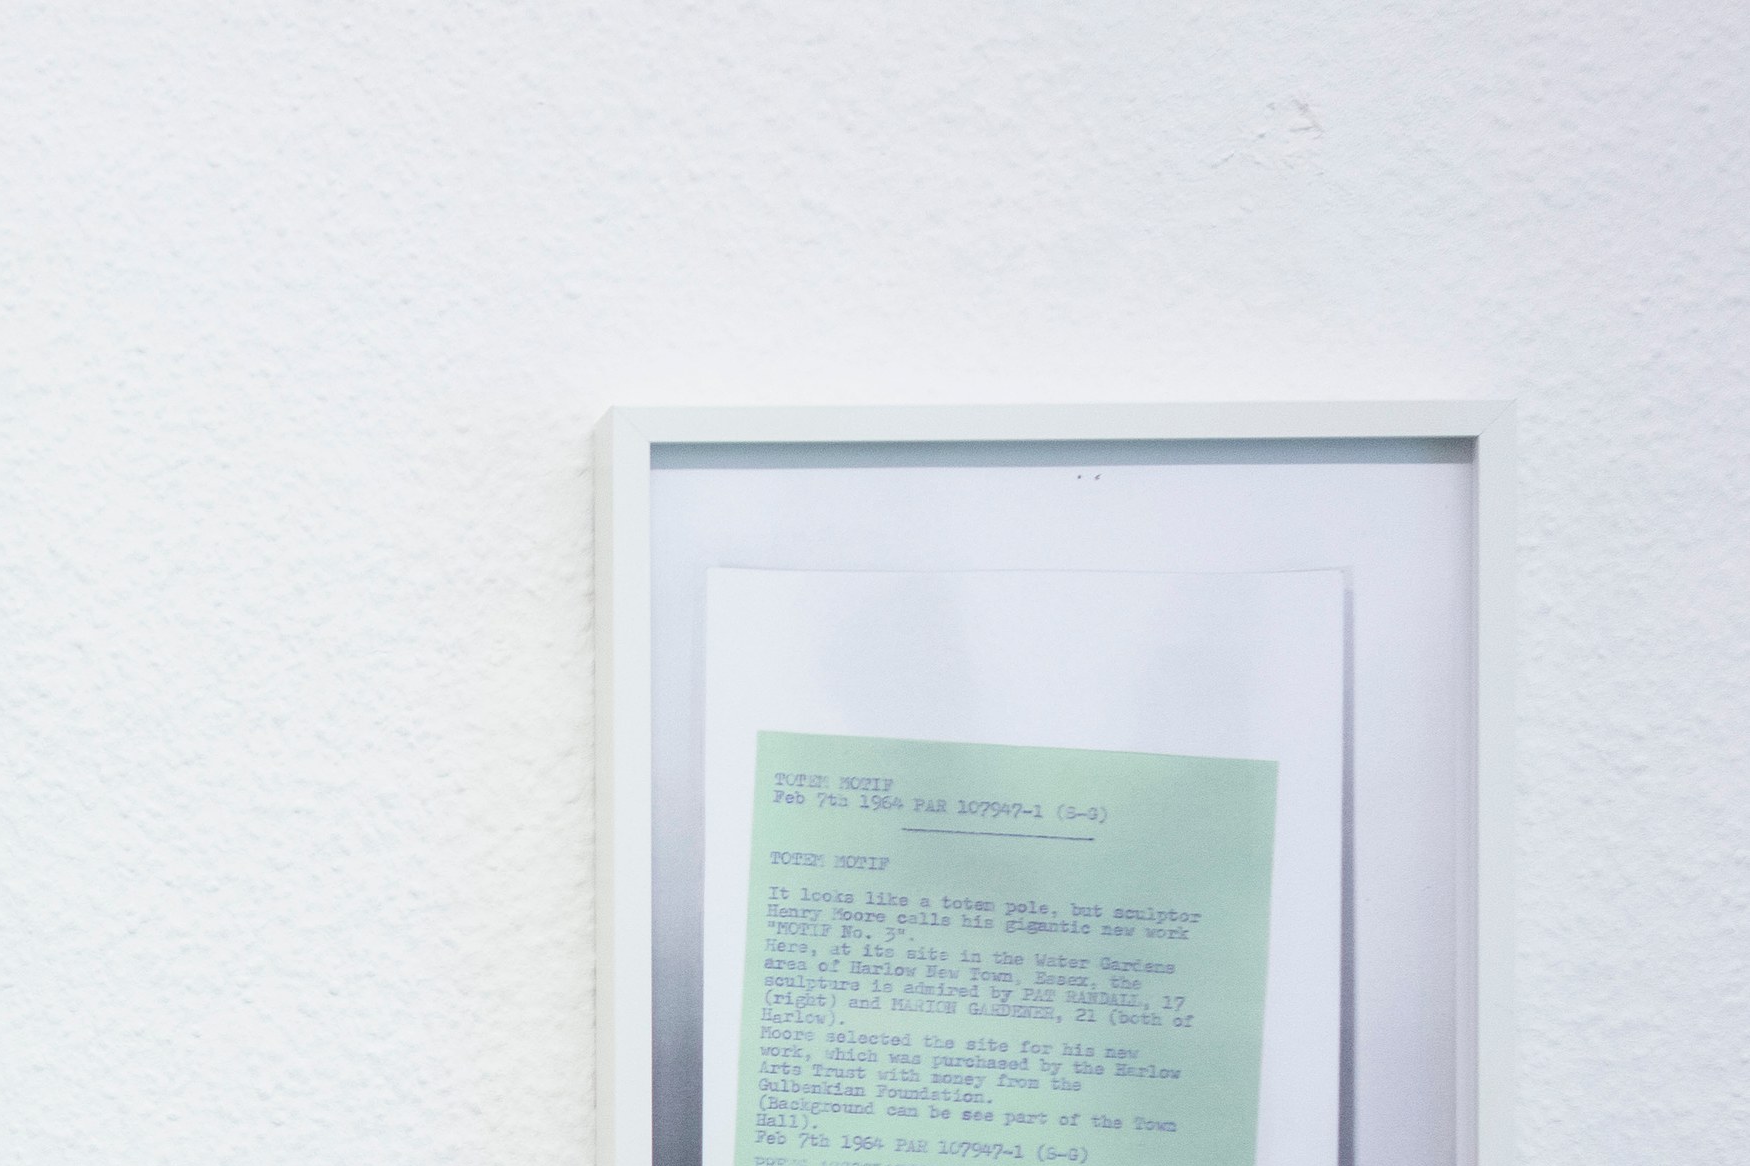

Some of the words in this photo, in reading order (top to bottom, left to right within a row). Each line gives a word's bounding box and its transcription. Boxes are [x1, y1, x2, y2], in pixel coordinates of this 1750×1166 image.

[774, 772, 831, 790] TOTEM
[839, 776, 894, 792] MOTIF
[774, 789, 805, 805] Feb
[817, 792, 848, 808] 7th
[859, 794, 904, 810] 1964
[913, 798, 947, 814] PAR
[957, 799, 1043, 818] 107947-1
[769, 851, 826, 867] TOTEM
[834, 855, 890, 871] MOTIF
[768, 886, 789, 900] It
[801, 888, 854, 904] looks
[866, 891, 909, 906] like
[920, 896, 930, 907] a
[942, 895, 996, 912] totem
[1005, 901, 1058, 918] pole,
[1071, 902, 1102, 918] but
[1113, 907, 1202, 924] sculptor
[766, 904, 822, 921] Henry
[832, 907, 886, 923] Moore
[897, 911, 951, 927] calls
[962, 914, 994, 929] his
[1005, 918, 1091, 935] gigantic
[1101, 924, 1135, 937] new
[1145, 927, 1190, 940] work
[767, 920, 832, 938] "MOTIF
[841, 924, 872, 939] No.
[885, 927, 914, 942] 3".
[764, 939, 817, 957] Here,
[831, 943, 851, 956] at
[862, 944, 895, 958] its
[907, 947, 949, 961] site
[960, 951, 981, 963] in
[993, 952, 1024, 965] the
[1035, 953, 1091, 969] Water
[1100, 957, 1176, 974] Gardens
[764, 958, 808, 971] area
[817, 958, 840, 973] of
[850, 961, 916, 977] Harlow
[925, 965, 960, 979] New
[1109, 975, 1142, 990] the
[764, 975, 860, 992] sculpture
[871, 979, 893, 992] is
[904, 982, 979, 998] admired
[990, 985, 1013, 1002] by
[1022, 988, 1055, 1002] PAT
[1162, 995, 1186, 1011] 17
[764, 989, 837, 1008] (right)
[848, 997, 882, 1009] and
[891, 998, 957, 1015] MARION
[1075, 1008, 1098, 1022] 21
[1109, 1008, 1162, 1027] (both
[1172, 1013, 1194, 1028] of
[760, 1007, 845, 1026] Harlow).
[760, 1026, 815, 1042] Moore
[826, 1030, 912, 1047] selected
[924, 1034, 955, 1049] the
[966, 1038, 1010, 1053] site
[1021, 1040, 1053, 1055] for
[1062, 1043, 1095, 1057] his
[1105, 1047, 1139, 1059] new
[758, 1061, 802, 1076] Arts
[812, 1064, 866, 1079] Trust
[878, 1068, 920, 1082] with
[931, 1073, 986, 1089] money
[997, 1073, 1039, 1089] from
[1051, 1076, 1081, 1091] the
[760, 1044, 812, 1061] work,
[825, 1047, 878, 1062] which
[888, 1052, 921, 1065] was
[932, 1053, 1029, 1070] purchased
[1040, 1057, 1062, 1076] by
[1073, 1060, 1105, 1075] the
[1114, 1063, 1182, 1079] Harlow
[758, 1078, 866, 1097] Gulbenkian
[876, 1084, 993, 1104] Foundation.
[756, 1113, 818, 1130] Hall).
[758, 1096, 875, 1116] (Background
[886, 1105, 919, 1117] can
[929, 1105, 951, 1120] be
[962, 1110, 994, 1122] see
[1004, 1110, 1048, 1126] part
[1059, 1113, 1080, 1127] of
[1091, 1114, 1122, 1129] the
[1132, 1117, 1177, 1132] Town
[754, 1130, 787, 1145] Feb
[799, 1132, 830, 1148] 7th
[840, 1134, 885, 1151] 1964
[894, 1138, 928, 1153] PAR
[938, 1140, 1024, 1159] 107947-1
